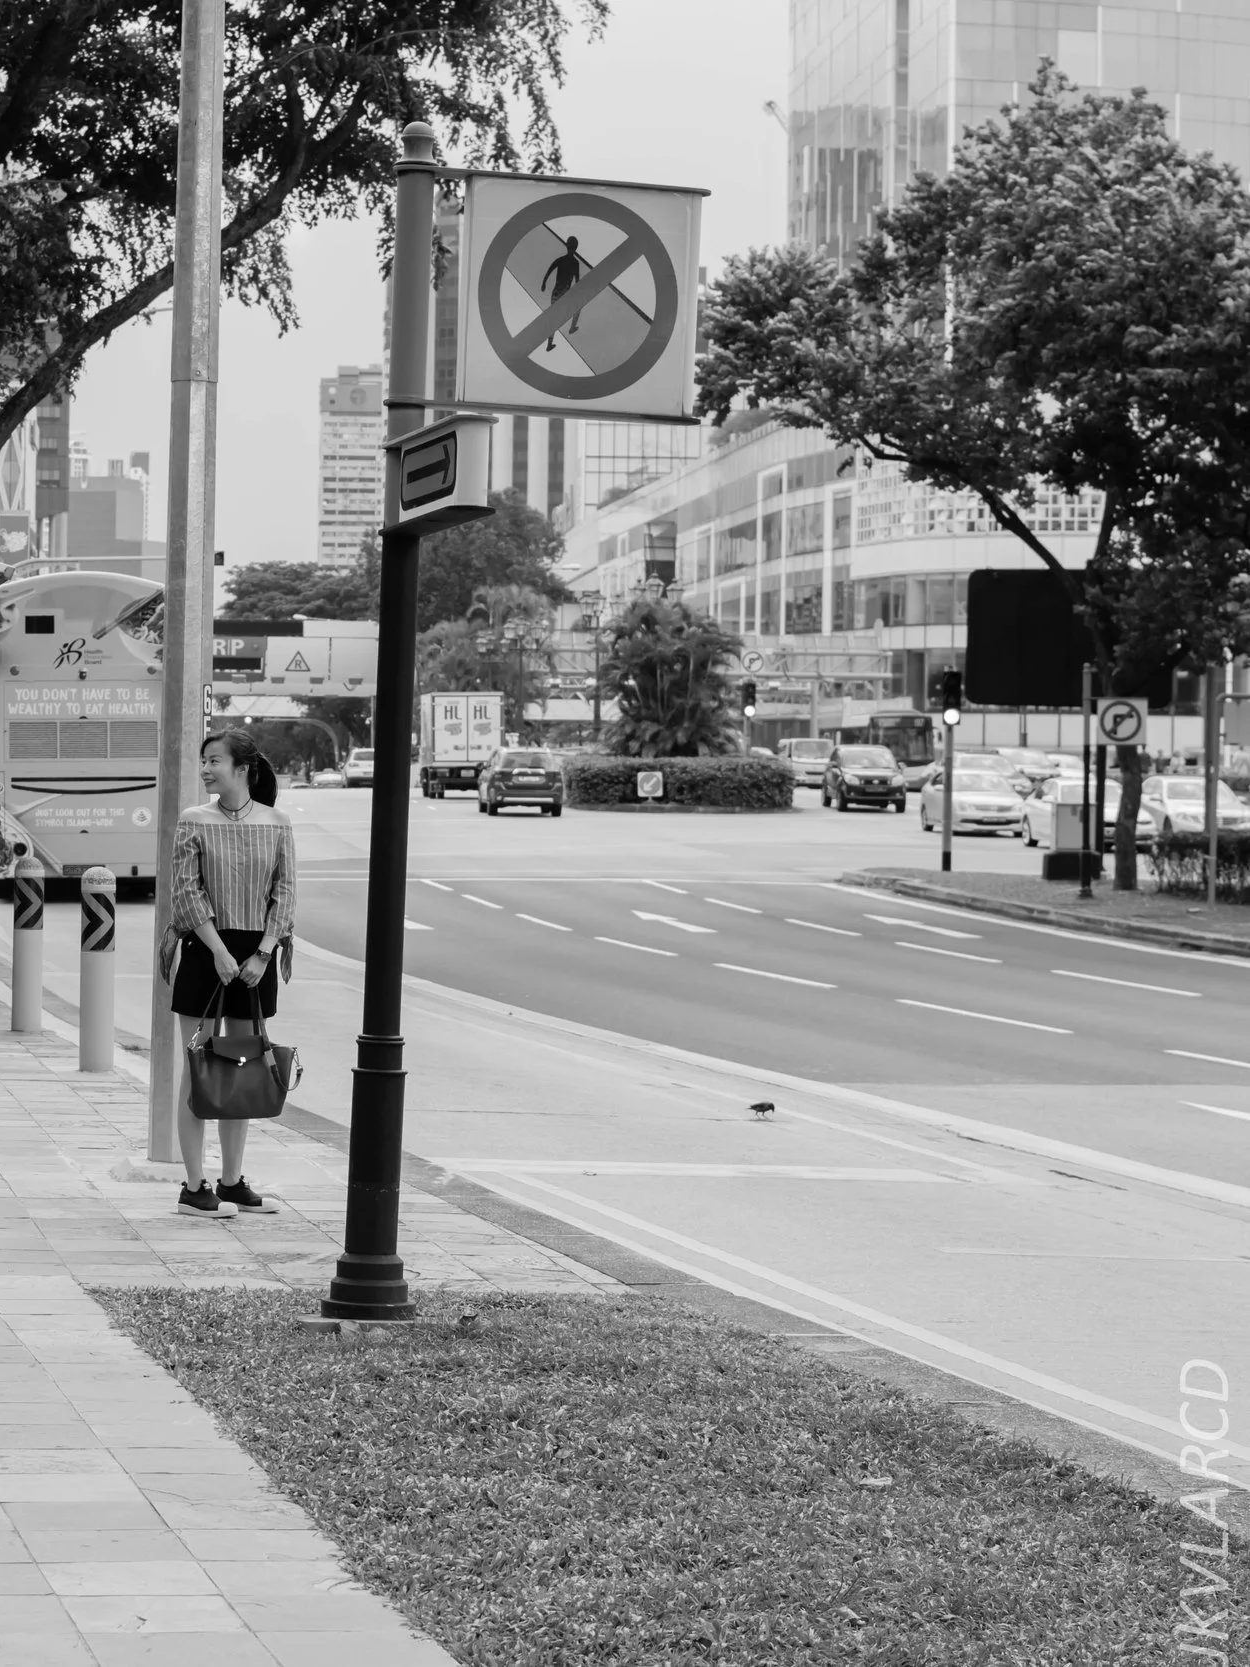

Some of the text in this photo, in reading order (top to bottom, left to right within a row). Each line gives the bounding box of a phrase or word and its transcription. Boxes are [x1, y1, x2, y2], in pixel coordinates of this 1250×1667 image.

[213, 638, 245, 656] RP
[294, 659, 302, 669] R
[14, 687, 150, 700] YOU DON'T HAVE TO BE
[8, 703, 158, 715] WEALTHY TO EAT HEALTHY.
[444, 705, 462, 720] HL
[474, 705, 492, 720] HL
[35, 807, 126, 817] JUST LOOK OUT FOR THIS
[35, 818, 64, 827] SYMBOL
